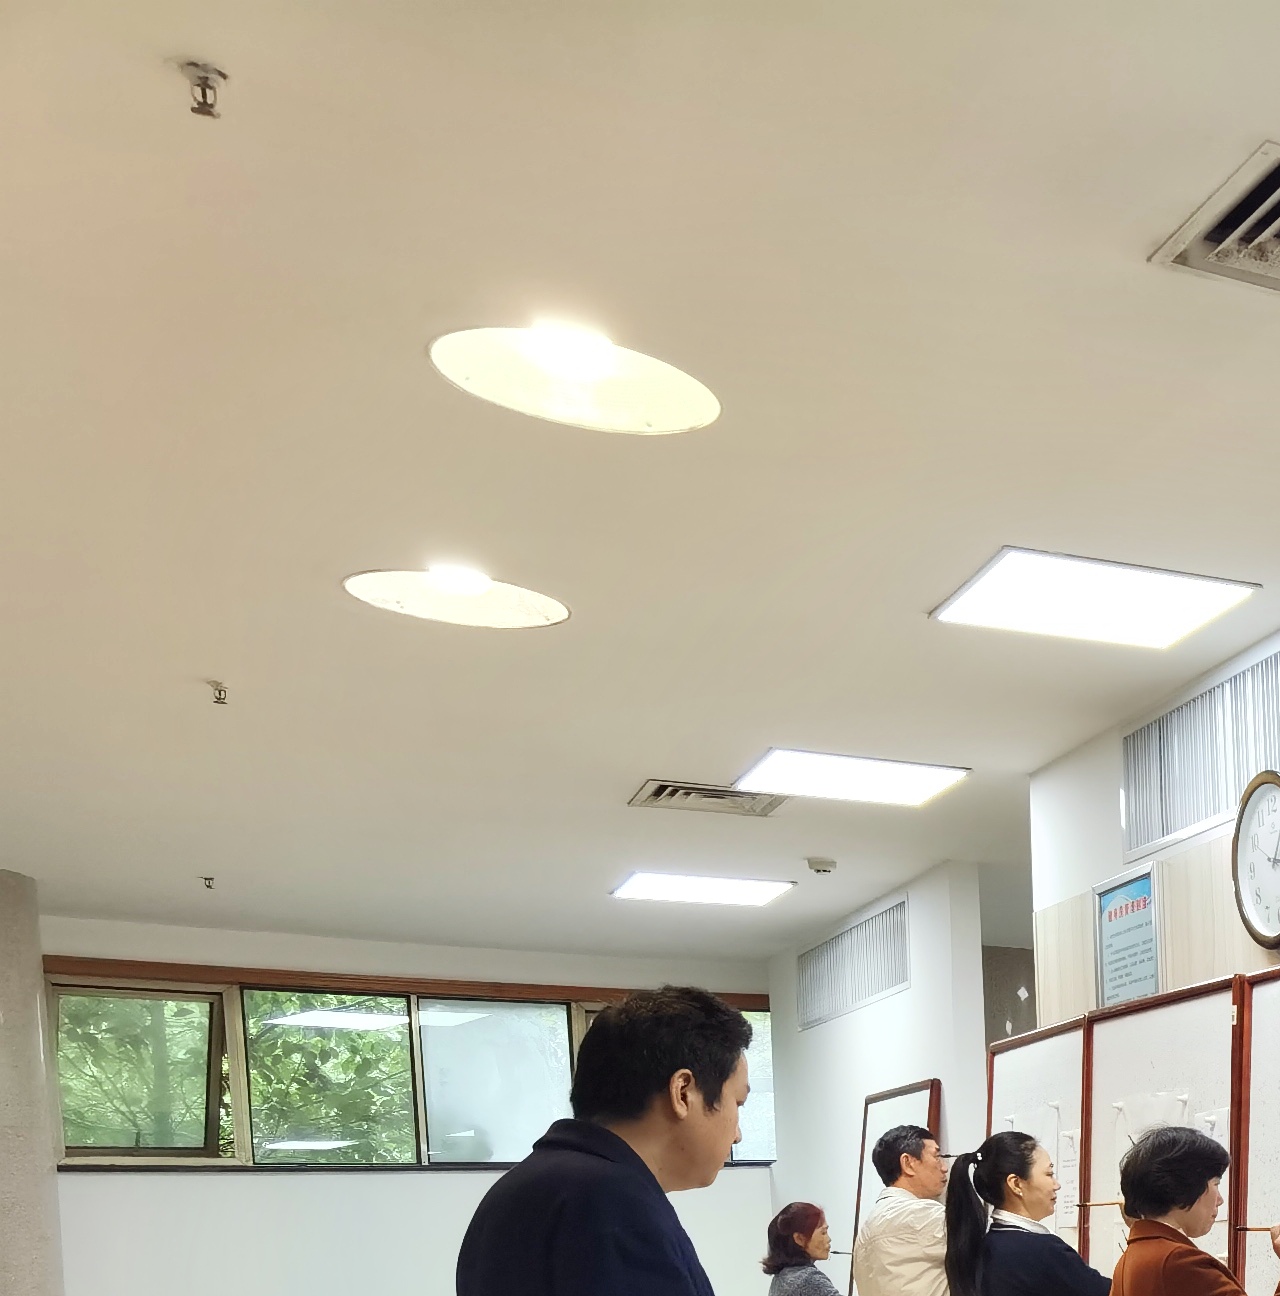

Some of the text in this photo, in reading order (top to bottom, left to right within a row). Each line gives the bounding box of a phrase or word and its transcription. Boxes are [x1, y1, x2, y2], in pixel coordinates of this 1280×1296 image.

[1267, 795, 1277, 816] 12
[1257, 809, 1265, 828] 11
[1251, 833, 1259, 853] 10
[1249, 861, 1256, 880] 9
[1255, 887, 1262, 905] 8
[1265, 905, 1271, 924] 7
